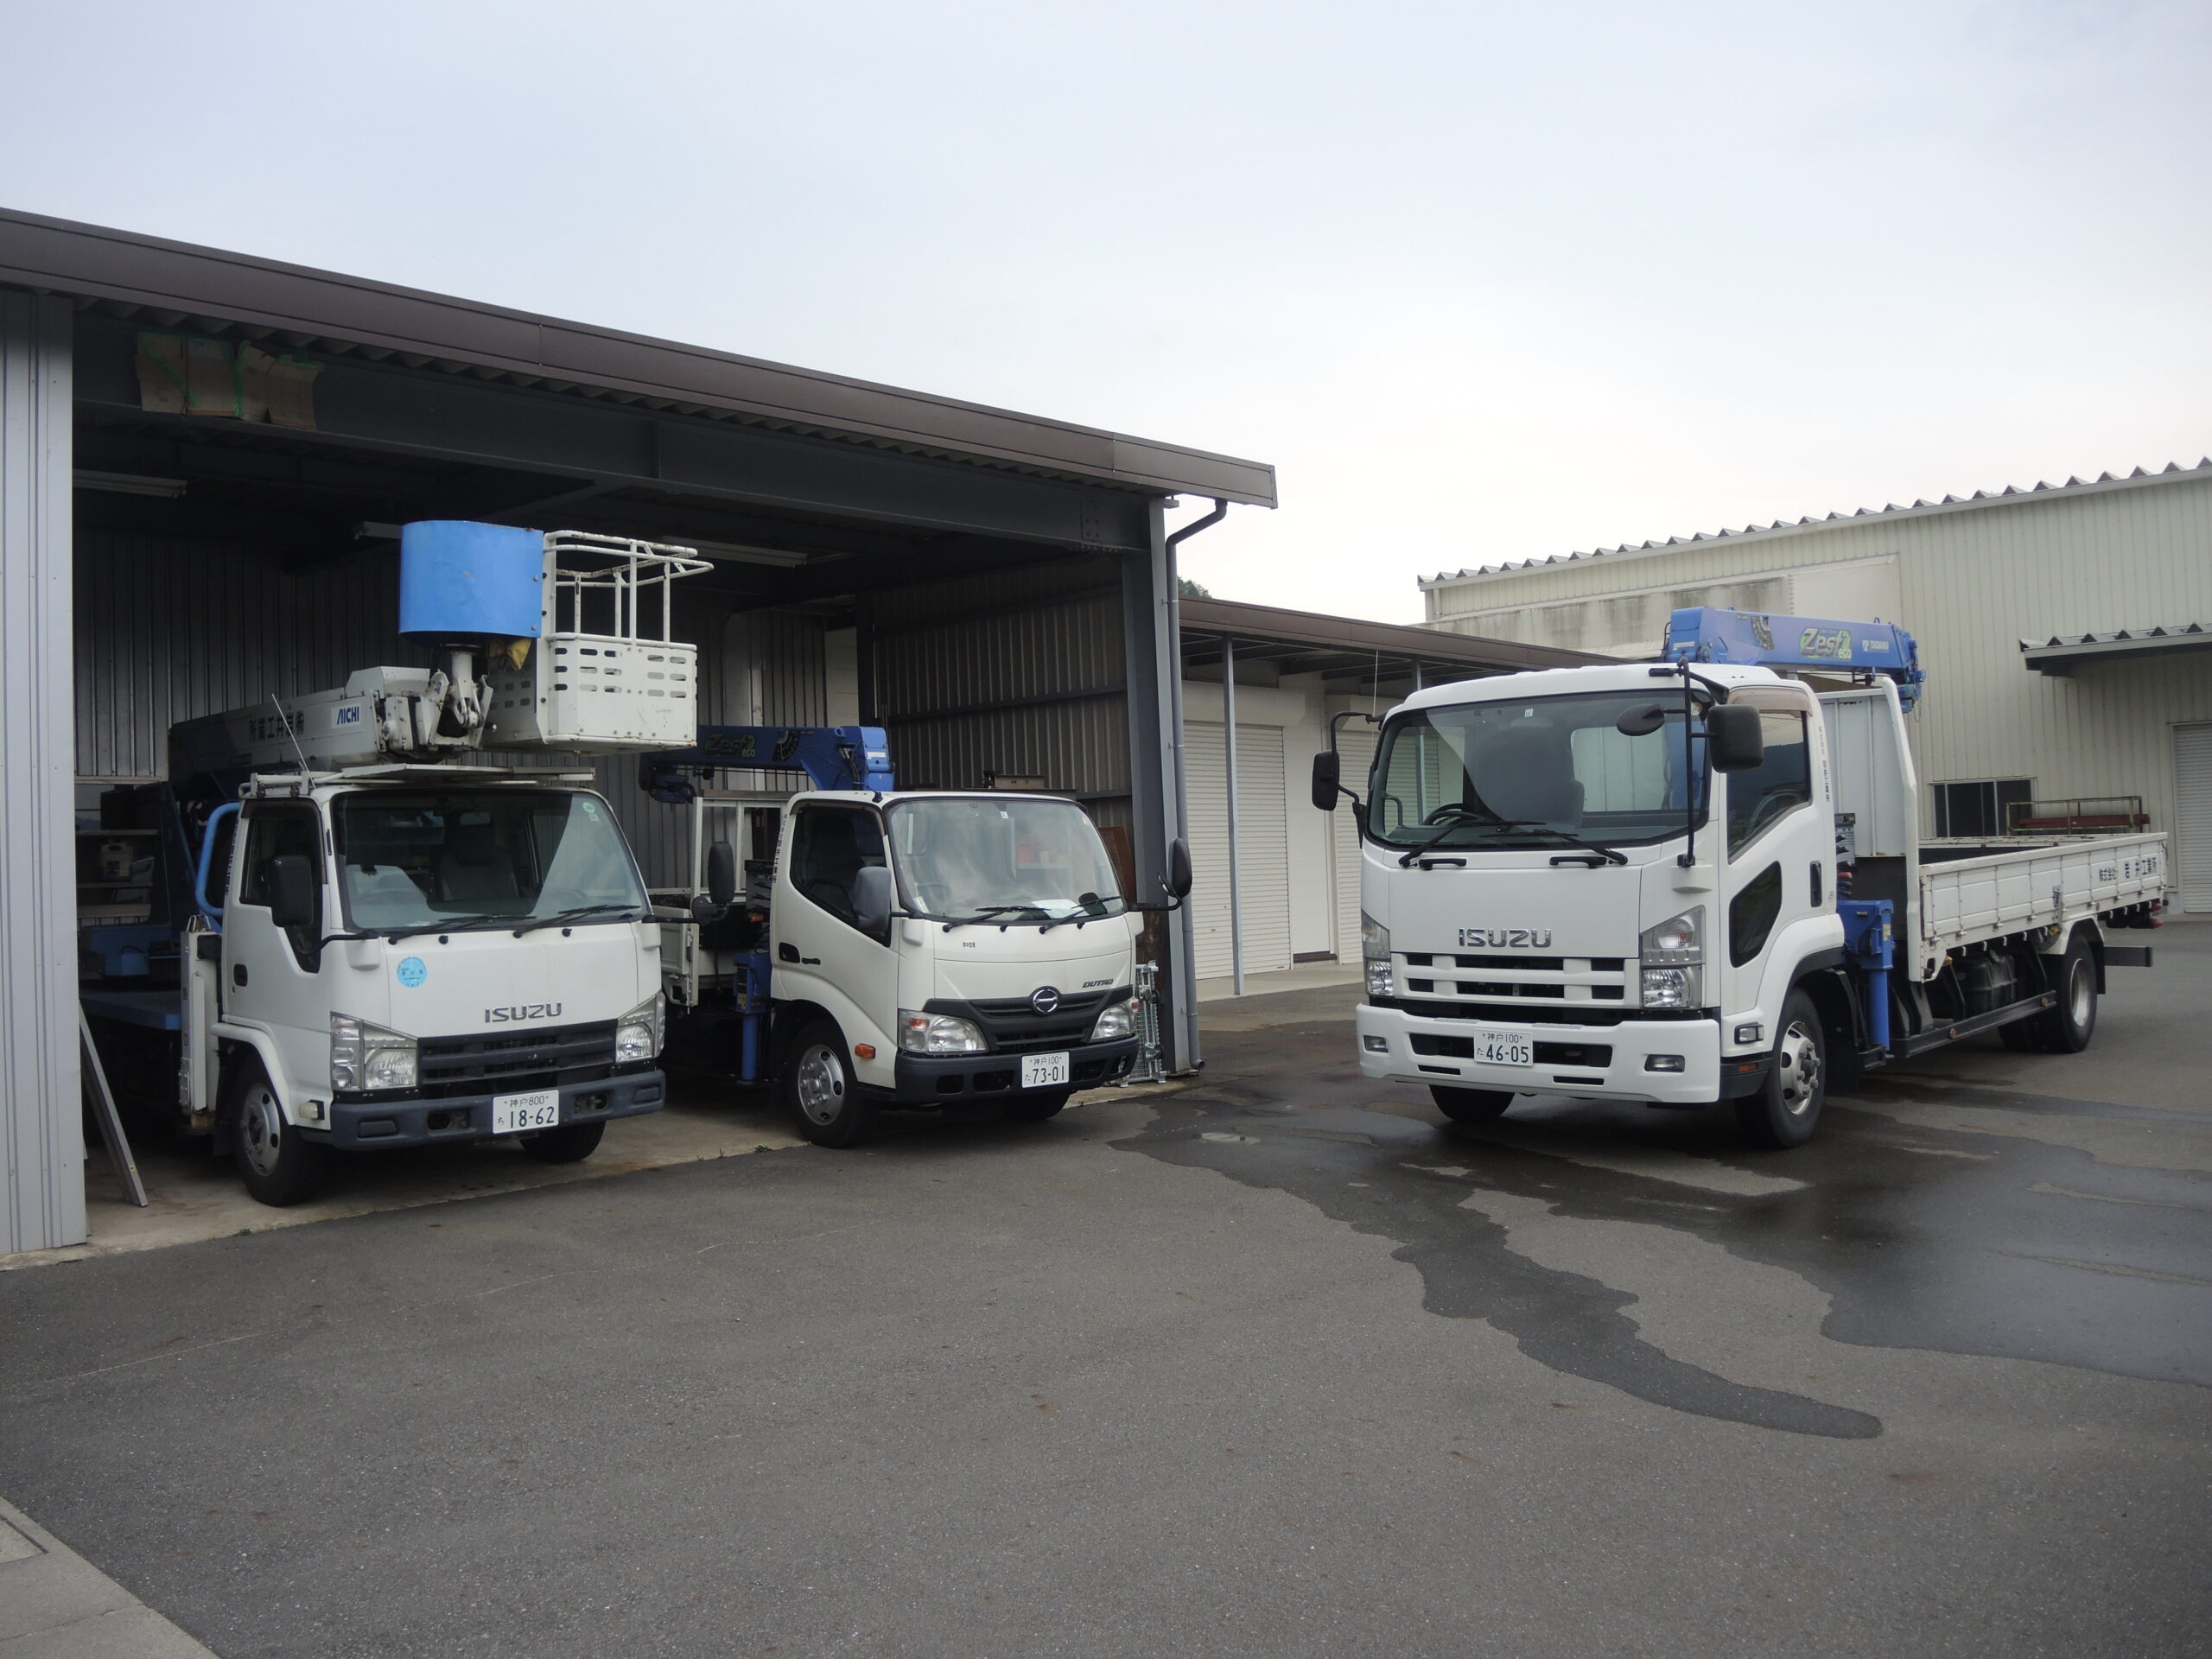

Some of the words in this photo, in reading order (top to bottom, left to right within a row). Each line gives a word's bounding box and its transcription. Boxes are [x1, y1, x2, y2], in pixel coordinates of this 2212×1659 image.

[1801, 627, 1843, 658] Zest
[1838, 648, 1852, 659] eco
[337, 706, 359, 725] AICHI
[741, 748, 756, 758] eco
[1459, 927, 1552, 948] ISUZU
[1082, 978, 1114, 988] DUTRO
[485, 1001, 563, 1023] ISUZU
[1486, 1043, 1529, 1063] 46-05
[1032, 1065, 1065, 1084] 73-01
[511, 1106, 555, 1128] 18-62
